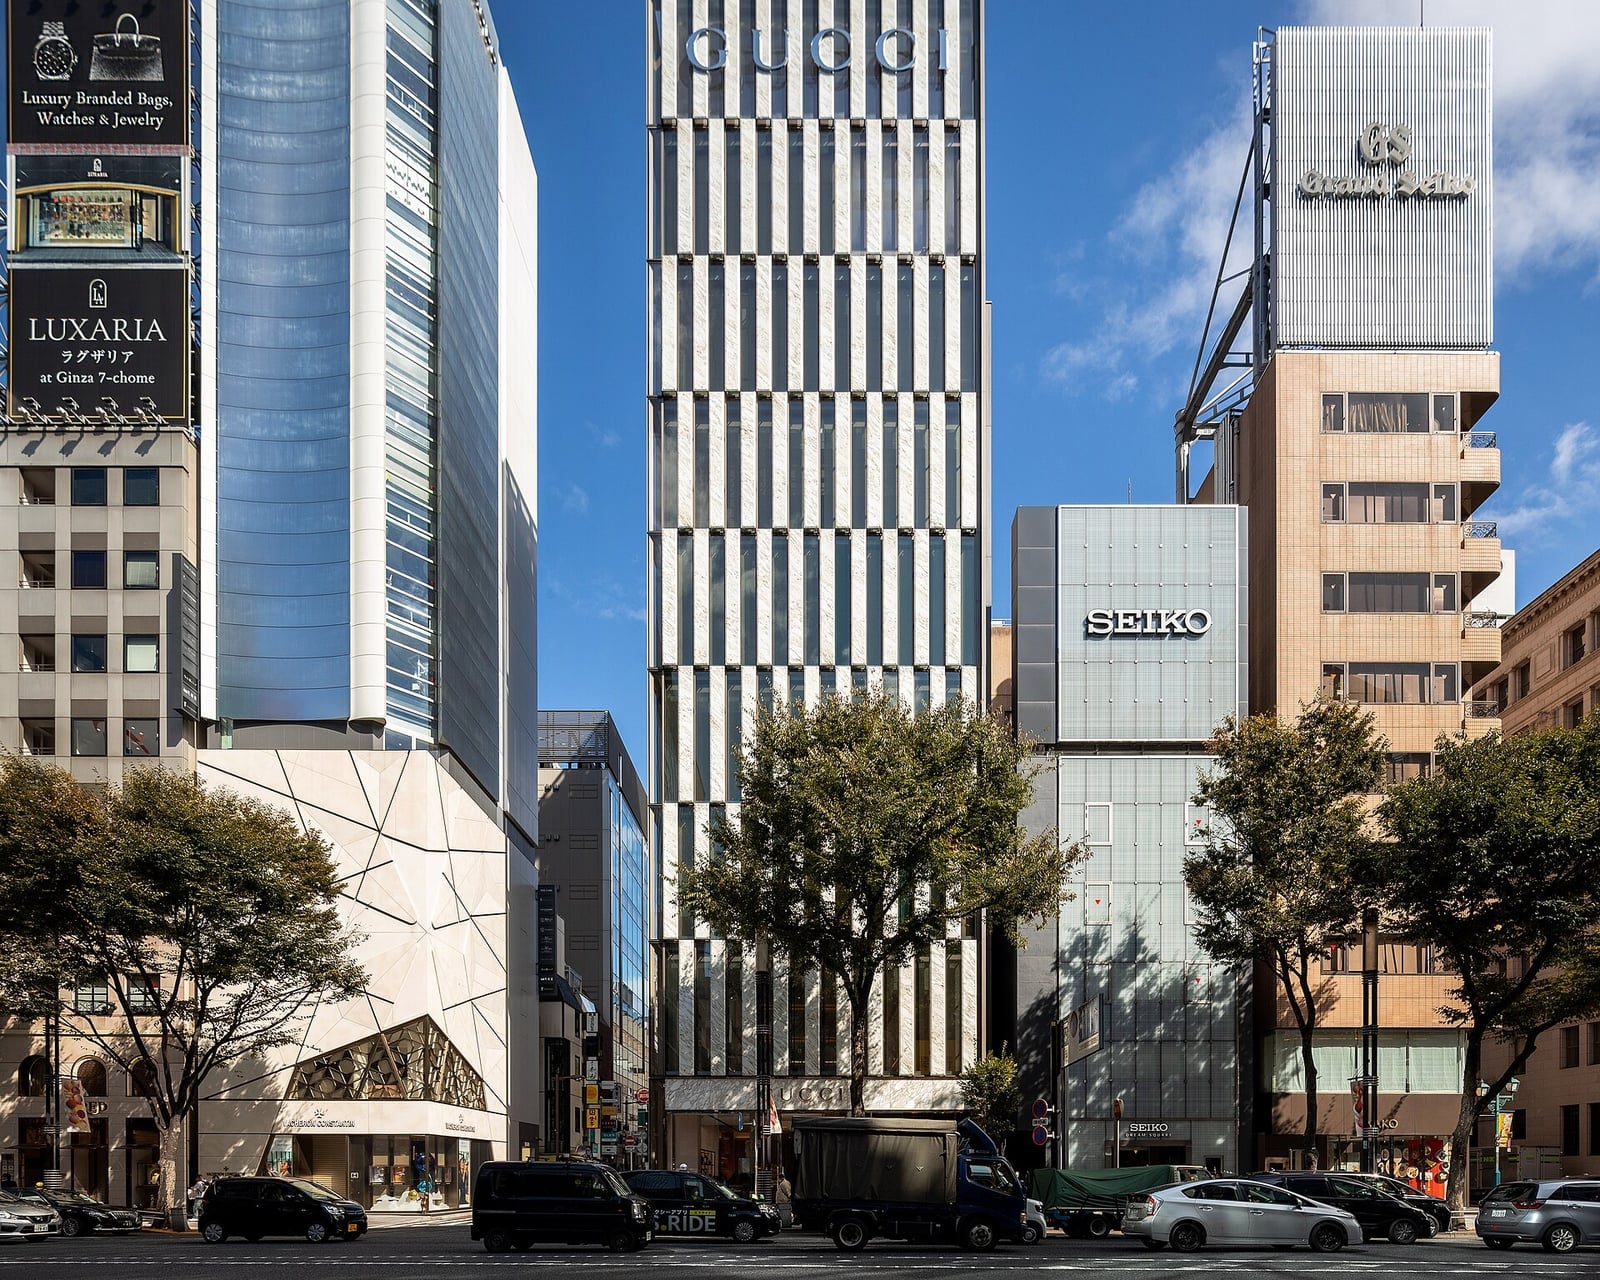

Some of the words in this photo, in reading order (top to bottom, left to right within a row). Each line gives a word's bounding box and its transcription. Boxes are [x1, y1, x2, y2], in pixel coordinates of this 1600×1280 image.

[686, 27, 949, 71] GUCCI
[22, 91, 71, 109] Luxury
[76, 91, 133, 105] Branded
[137, 92, 173, 110] Bags,
[37, 111, 94, 125] Watches
[99, 114, 109, 125] &
[112, 112, 164, 130] Jewelry
[1360, 122, 1413, 165] GS
[1300, 168, 1389, 197] Grand
[1397, 170, 1476, 198] Seiko
[28, 318, 167, 342] LUXARIA
[61, 350, 134, 364] ラグザリア
[40, 374, 52, 383] at
[56, 371, 94, 384] Ginza
[98, 371, 155, 384] 7-chome
[1086, 608, 1212, 635] SEIKO
[779, 1087, 844, 1102] UCCI
[1129, 1123, 1168, 1132] SEIKO
